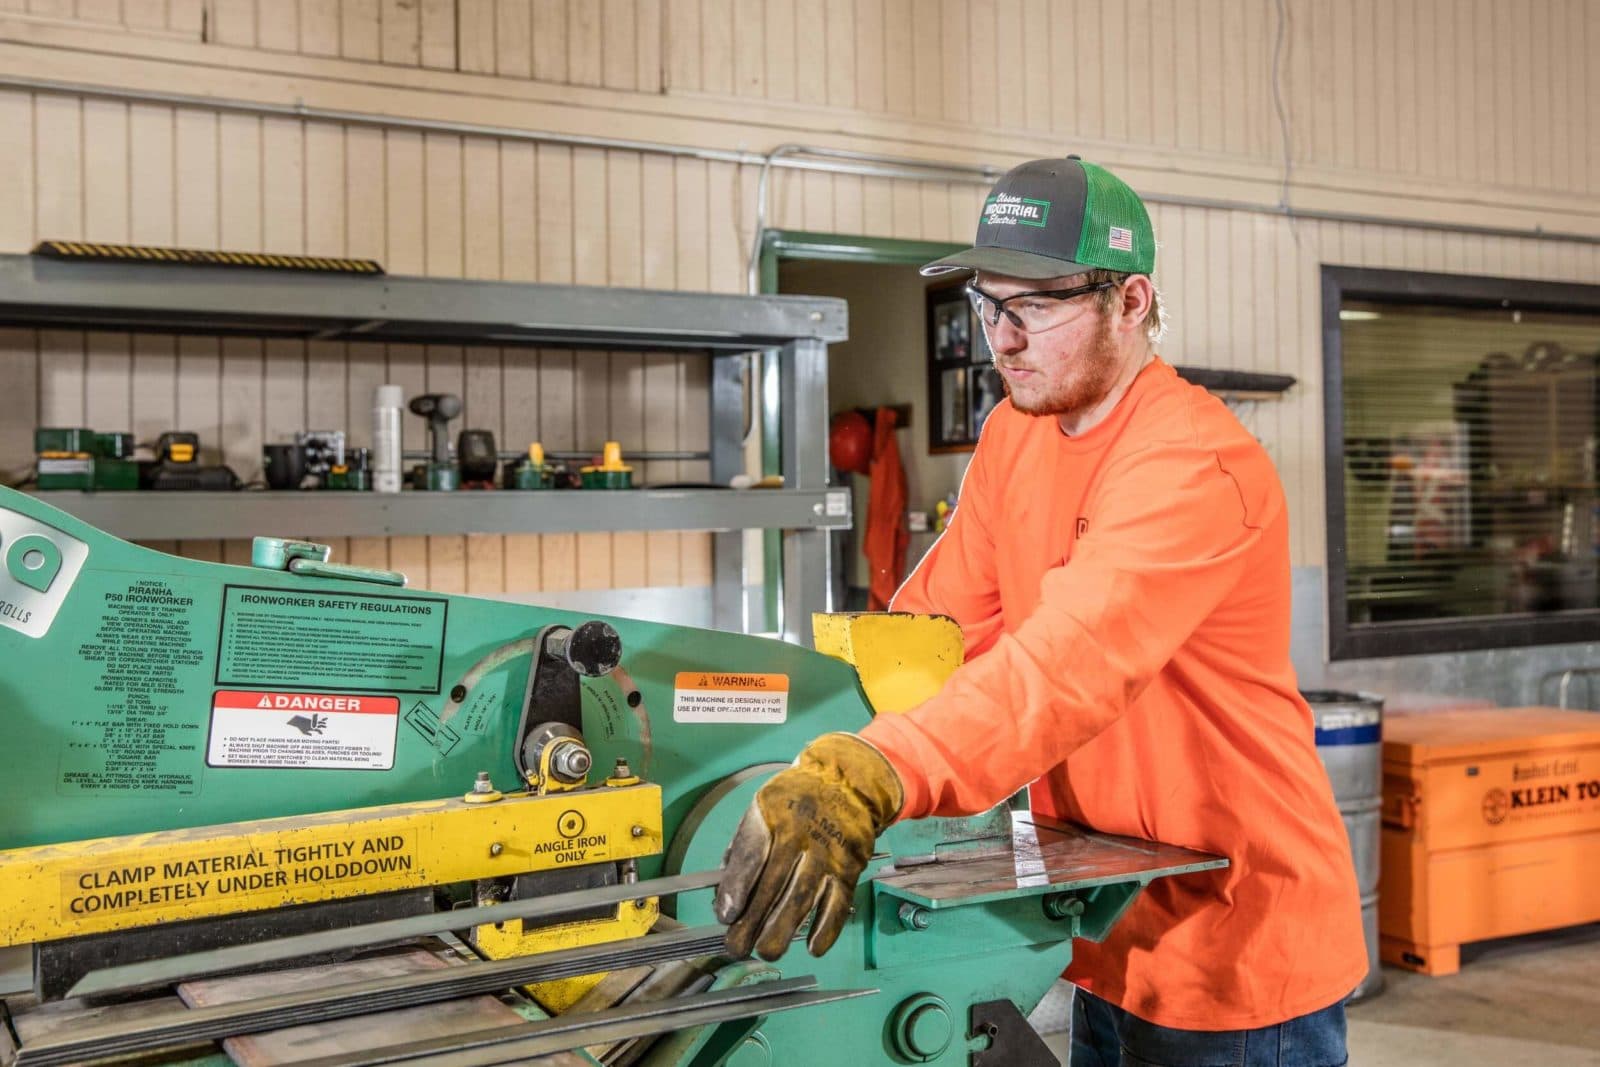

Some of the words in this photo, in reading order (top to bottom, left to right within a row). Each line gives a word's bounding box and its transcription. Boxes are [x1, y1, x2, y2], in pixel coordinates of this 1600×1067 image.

[105, 593, 122, 602] P50
[126, 594, 193, 606] IRONWORKER
[128, 586, 172, 596] PIRANHA
[240, 594, 315, 607] IRONWORKER
[318, 600, 358, 610] SAFETY
[360, 602, 432, 614] REGULATIONS
[712, 676, 767, 687] WARNING
[275, 695, 360, 711] DANGER
[1510, 785, 1569, 808] KLEIN
[534, 840, 574, 854] ANGLE
[577, 835, 606, 848] IRON
[80, 866, 156, 890] CLAMP
[164, 852, 269, 880] MATERIAL
[274, 841, 354, 865] TIGHTLY
[362, 836, 404, 855] AND
[555, 850, 587, 863] ONLY
[71, 880, 210, 914] COMPLETELY
[218, 871, 288, 894] UNDER
[296, 856, 412, 884] HOLDDOWN
